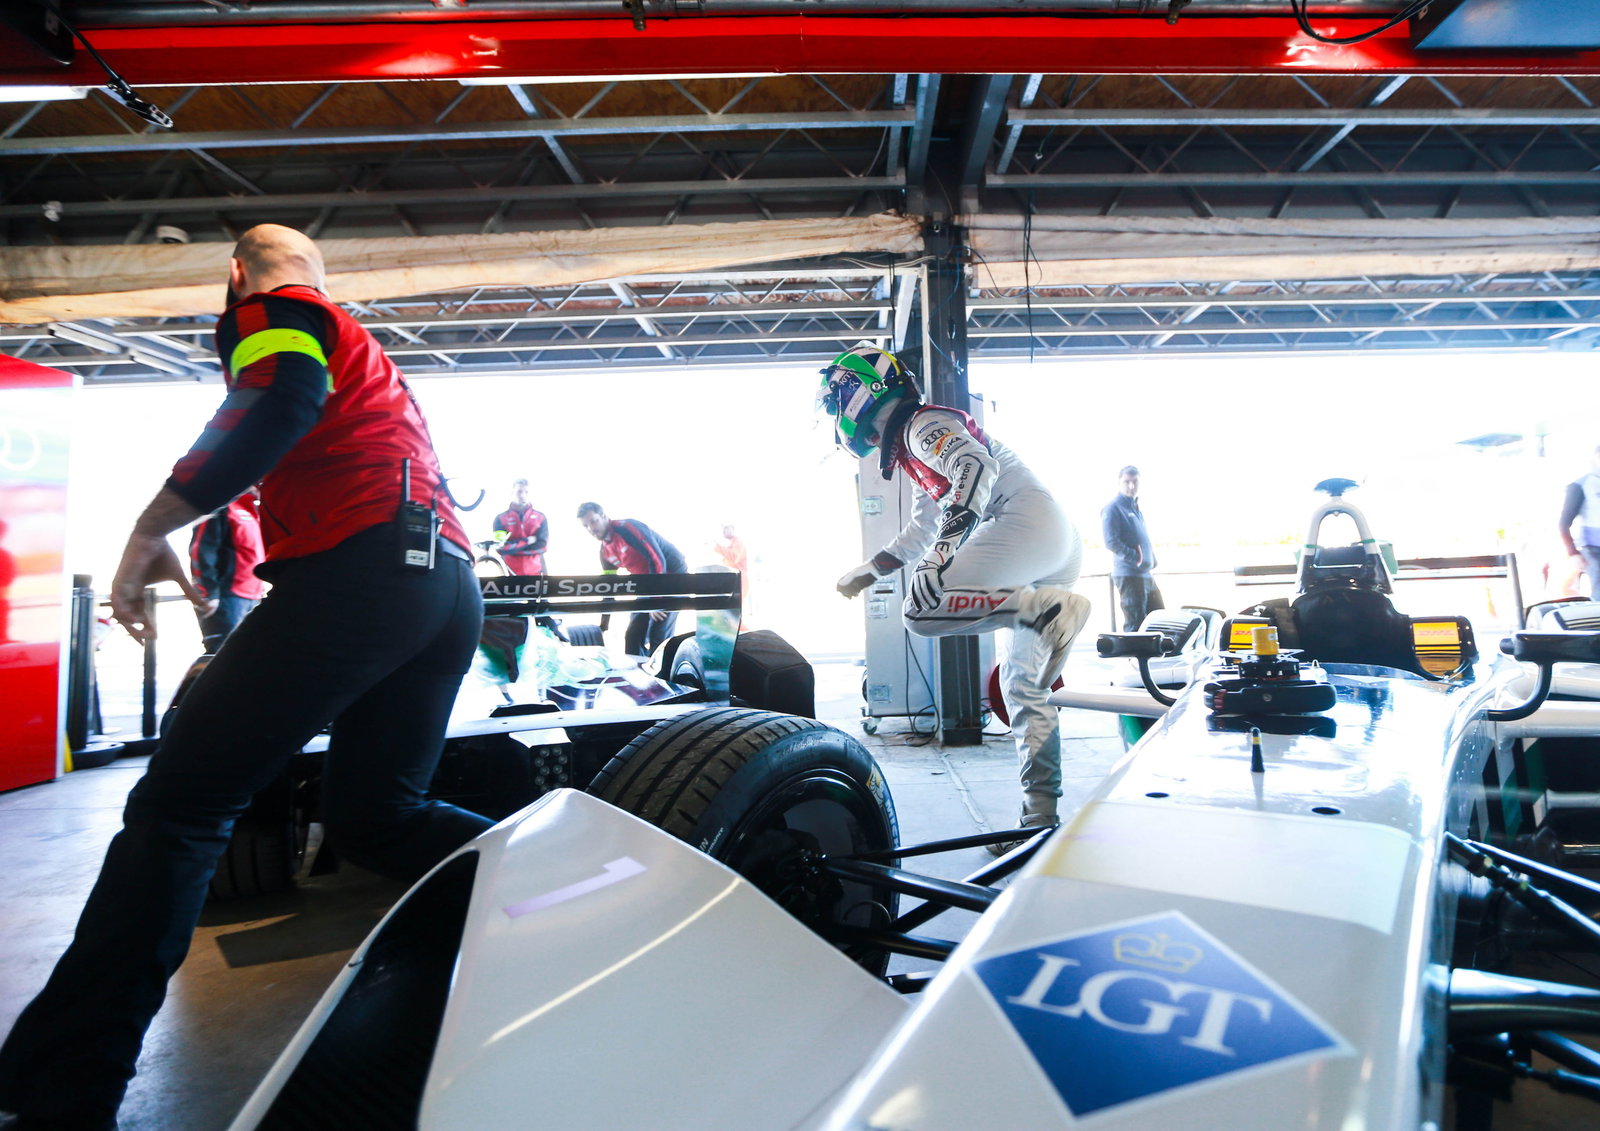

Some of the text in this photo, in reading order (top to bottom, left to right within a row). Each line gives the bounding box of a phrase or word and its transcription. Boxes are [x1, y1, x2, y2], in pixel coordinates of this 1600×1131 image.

[939, 436, 963, 459] KUKA
[958, 462, 973, 489] e-tron
[483, 579, 637, 596] Audi Sport
[947, 596, 1008, 613] Audi
[1006, 952, 1273, 1057] LGT
